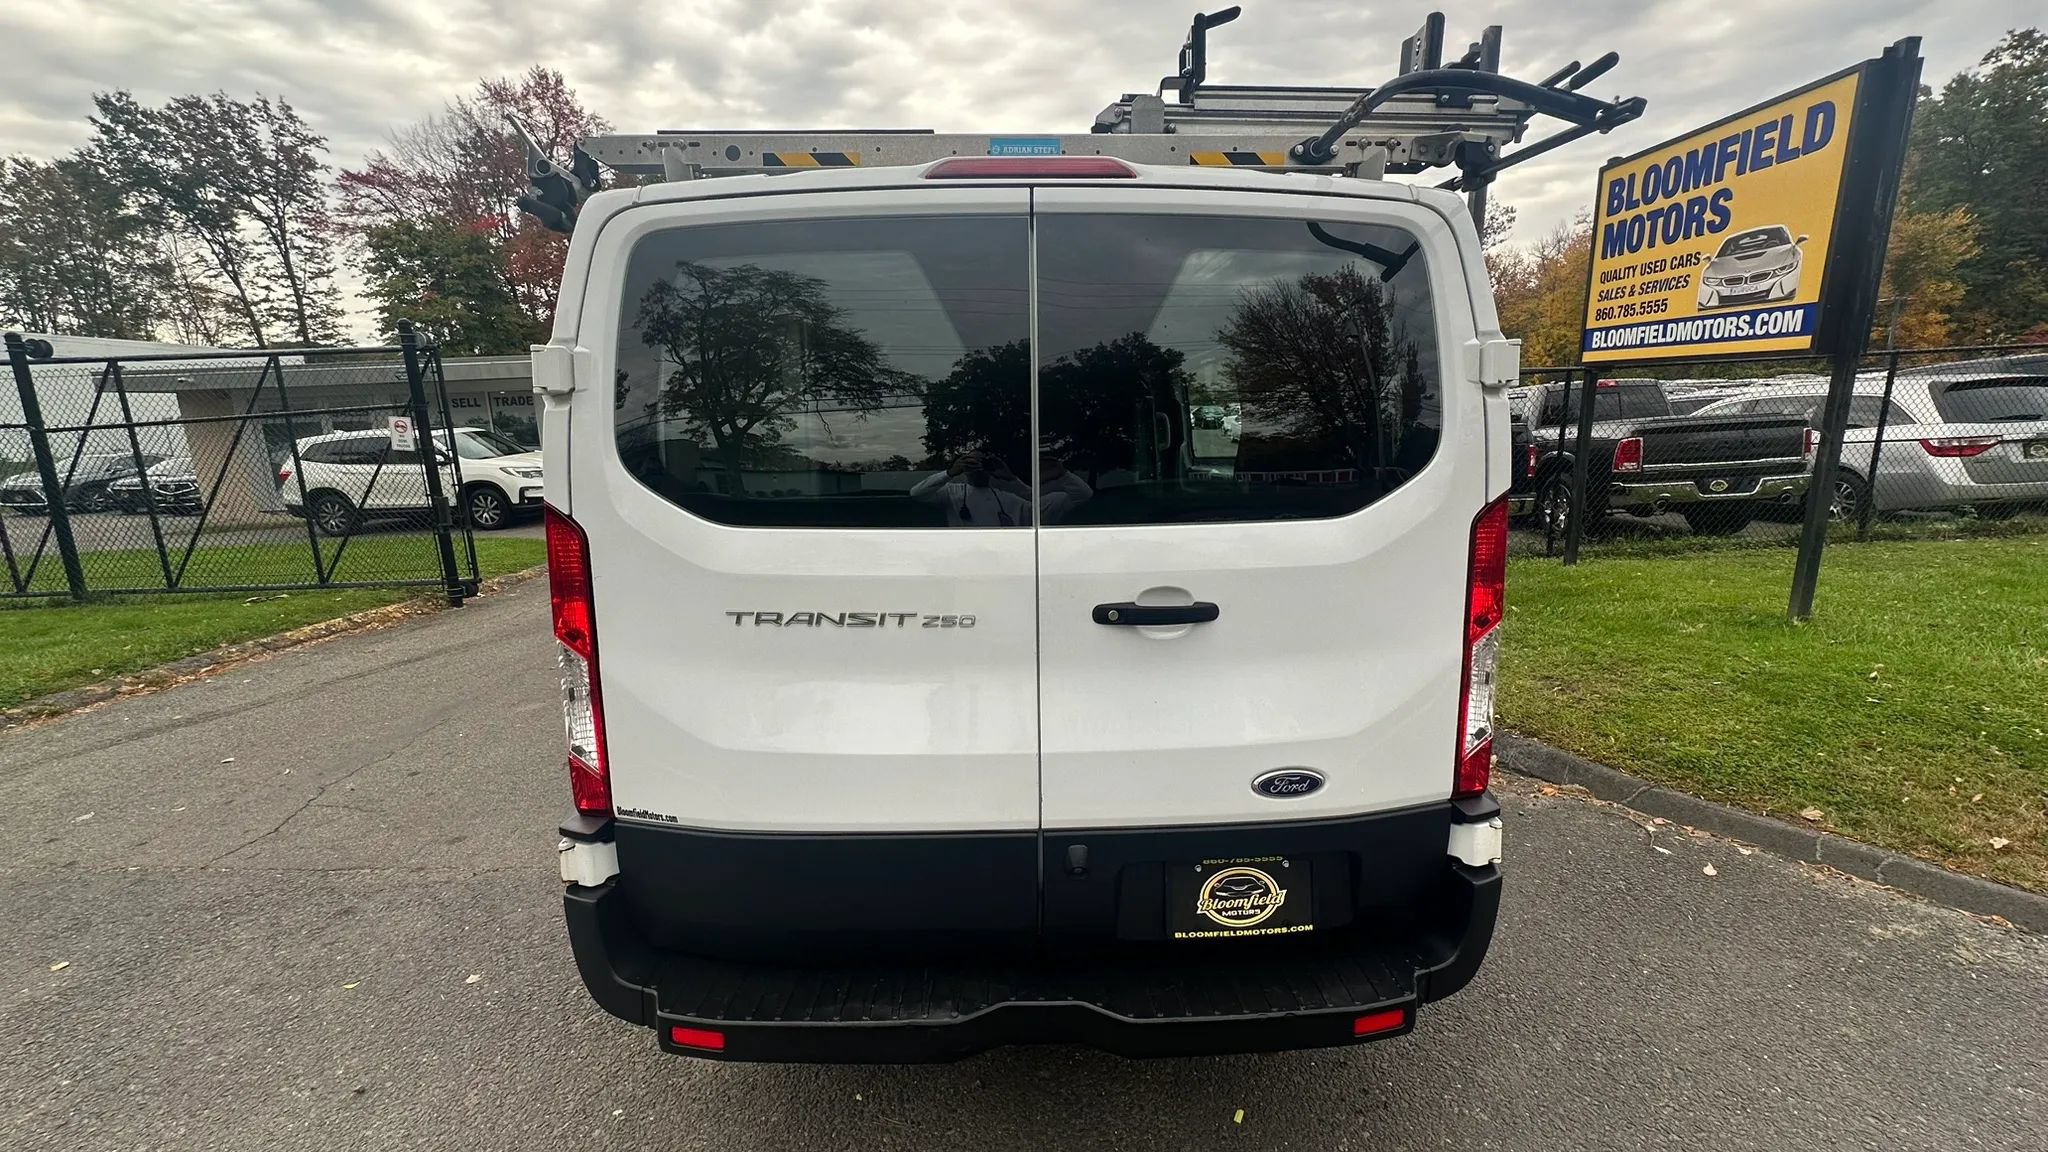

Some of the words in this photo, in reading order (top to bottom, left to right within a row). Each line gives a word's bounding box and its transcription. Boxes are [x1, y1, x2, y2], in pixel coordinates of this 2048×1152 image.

[1003, 145, 1032, 154] ADRIAN
[1606, 100, 1836, 218] BLOOMFIELD
[1601, 187, 1733, 260] MOTORS
[1600, 264, 1638, 284] QUALITY
[1640, 258, 1667, 276] USED
[1670, 251, 1701, 270] CARS
[1597, 285, 1627, 302] SALES
[1628, 284, 1637, 297] &
[1638, 274, 1691, 295] SERVICES
[1595, 298, 1668, 321] 860.785.5555
[1591, 309, 1804, 348] BLOOMFIELDMOTORS.COM
[452, 397, 481, 408] SELL
[493, 395, 534, 407] TRADE
[725, 611, 918, 628] TRANSIT
[921, 614, 977, 629] 250
[1270, 776, 1311, 793] Ford
[1202, 892, 1281, 911] Bloomfield
[1222, 908, 1261, 917] MOTORS
[1174, 924, 1314, 939] BLOOMFIELDMOTORS.COM
